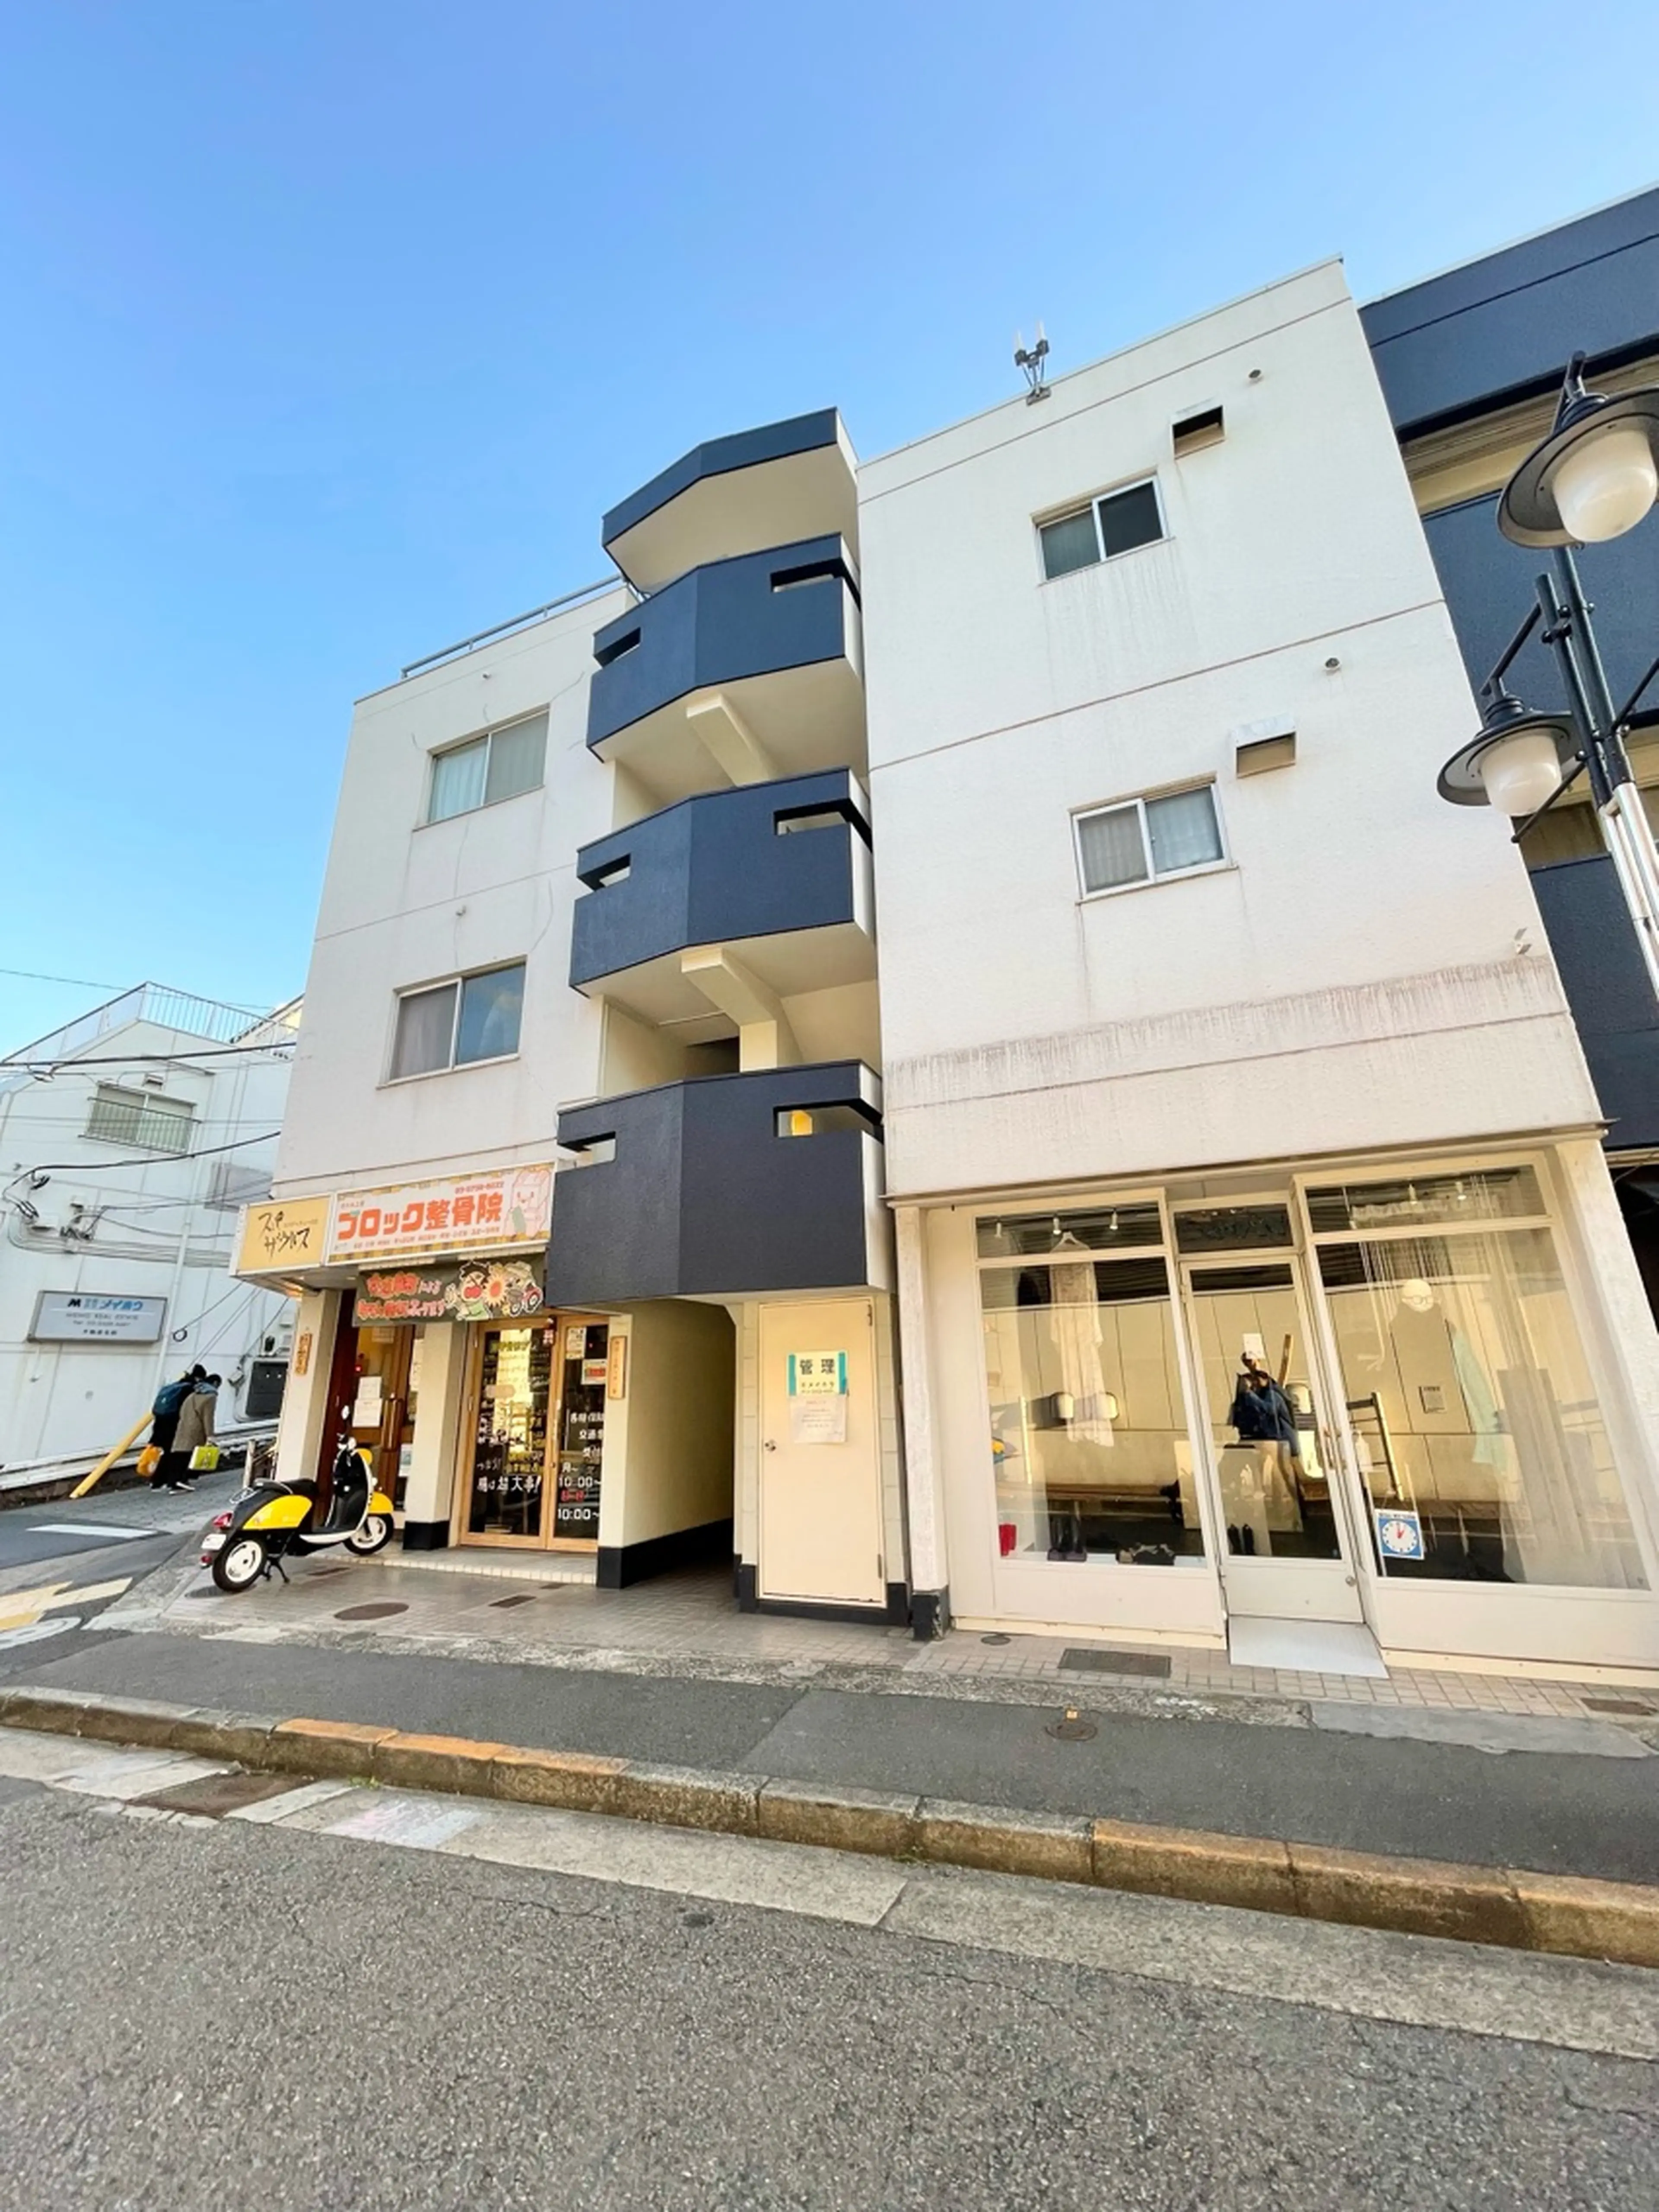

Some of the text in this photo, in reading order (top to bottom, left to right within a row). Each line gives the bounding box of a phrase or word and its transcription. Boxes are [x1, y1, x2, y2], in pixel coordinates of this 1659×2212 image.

[338, 1192, 503, 1241] ブロック整骨院
